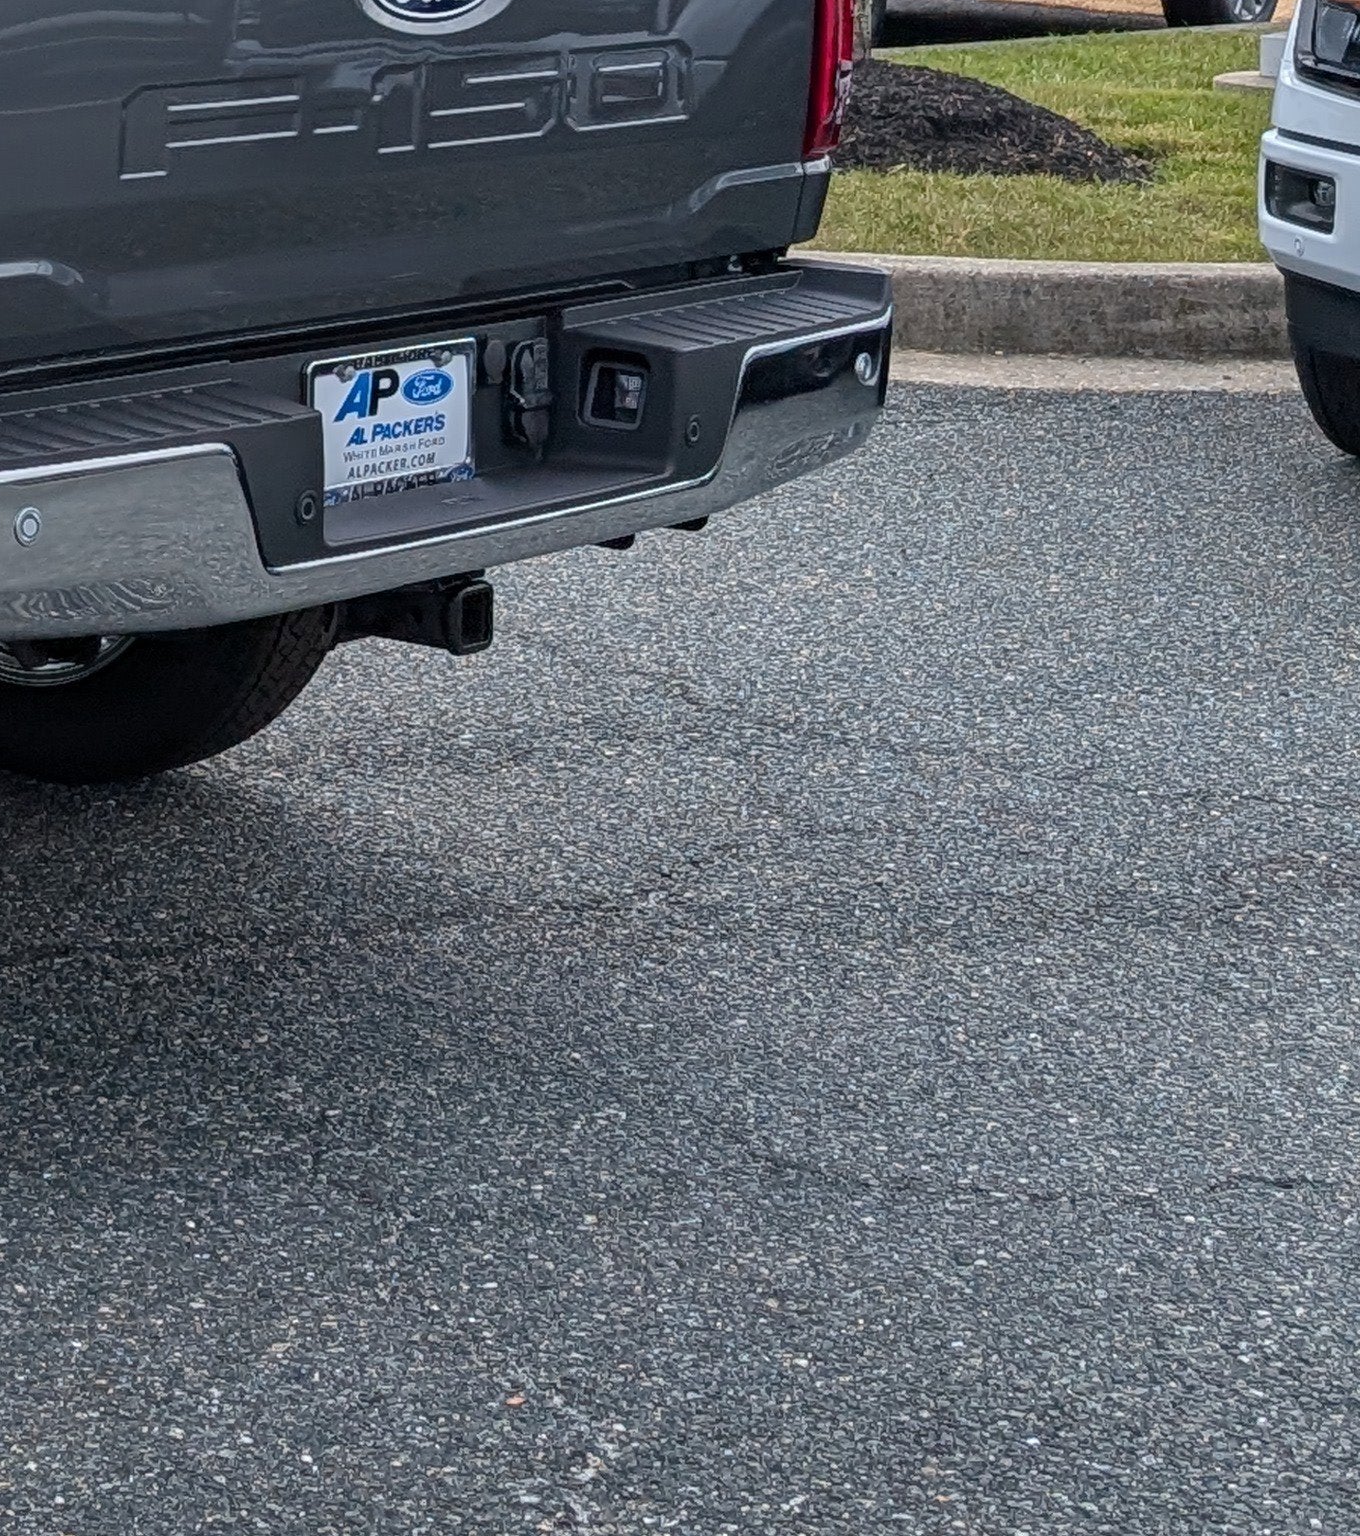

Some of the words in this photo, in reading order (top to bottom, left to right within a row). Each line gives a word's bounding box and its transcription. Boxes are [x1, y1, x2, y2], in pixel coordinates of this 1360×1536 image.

[118, 38, 694, 180] F-150
[333, 368, 400, 424] AP
[346, 425, 369, 449] AL
[371, 411, 446, 443] PACKER'S
[347, 452, 437, 480] ALPACKER.COM
